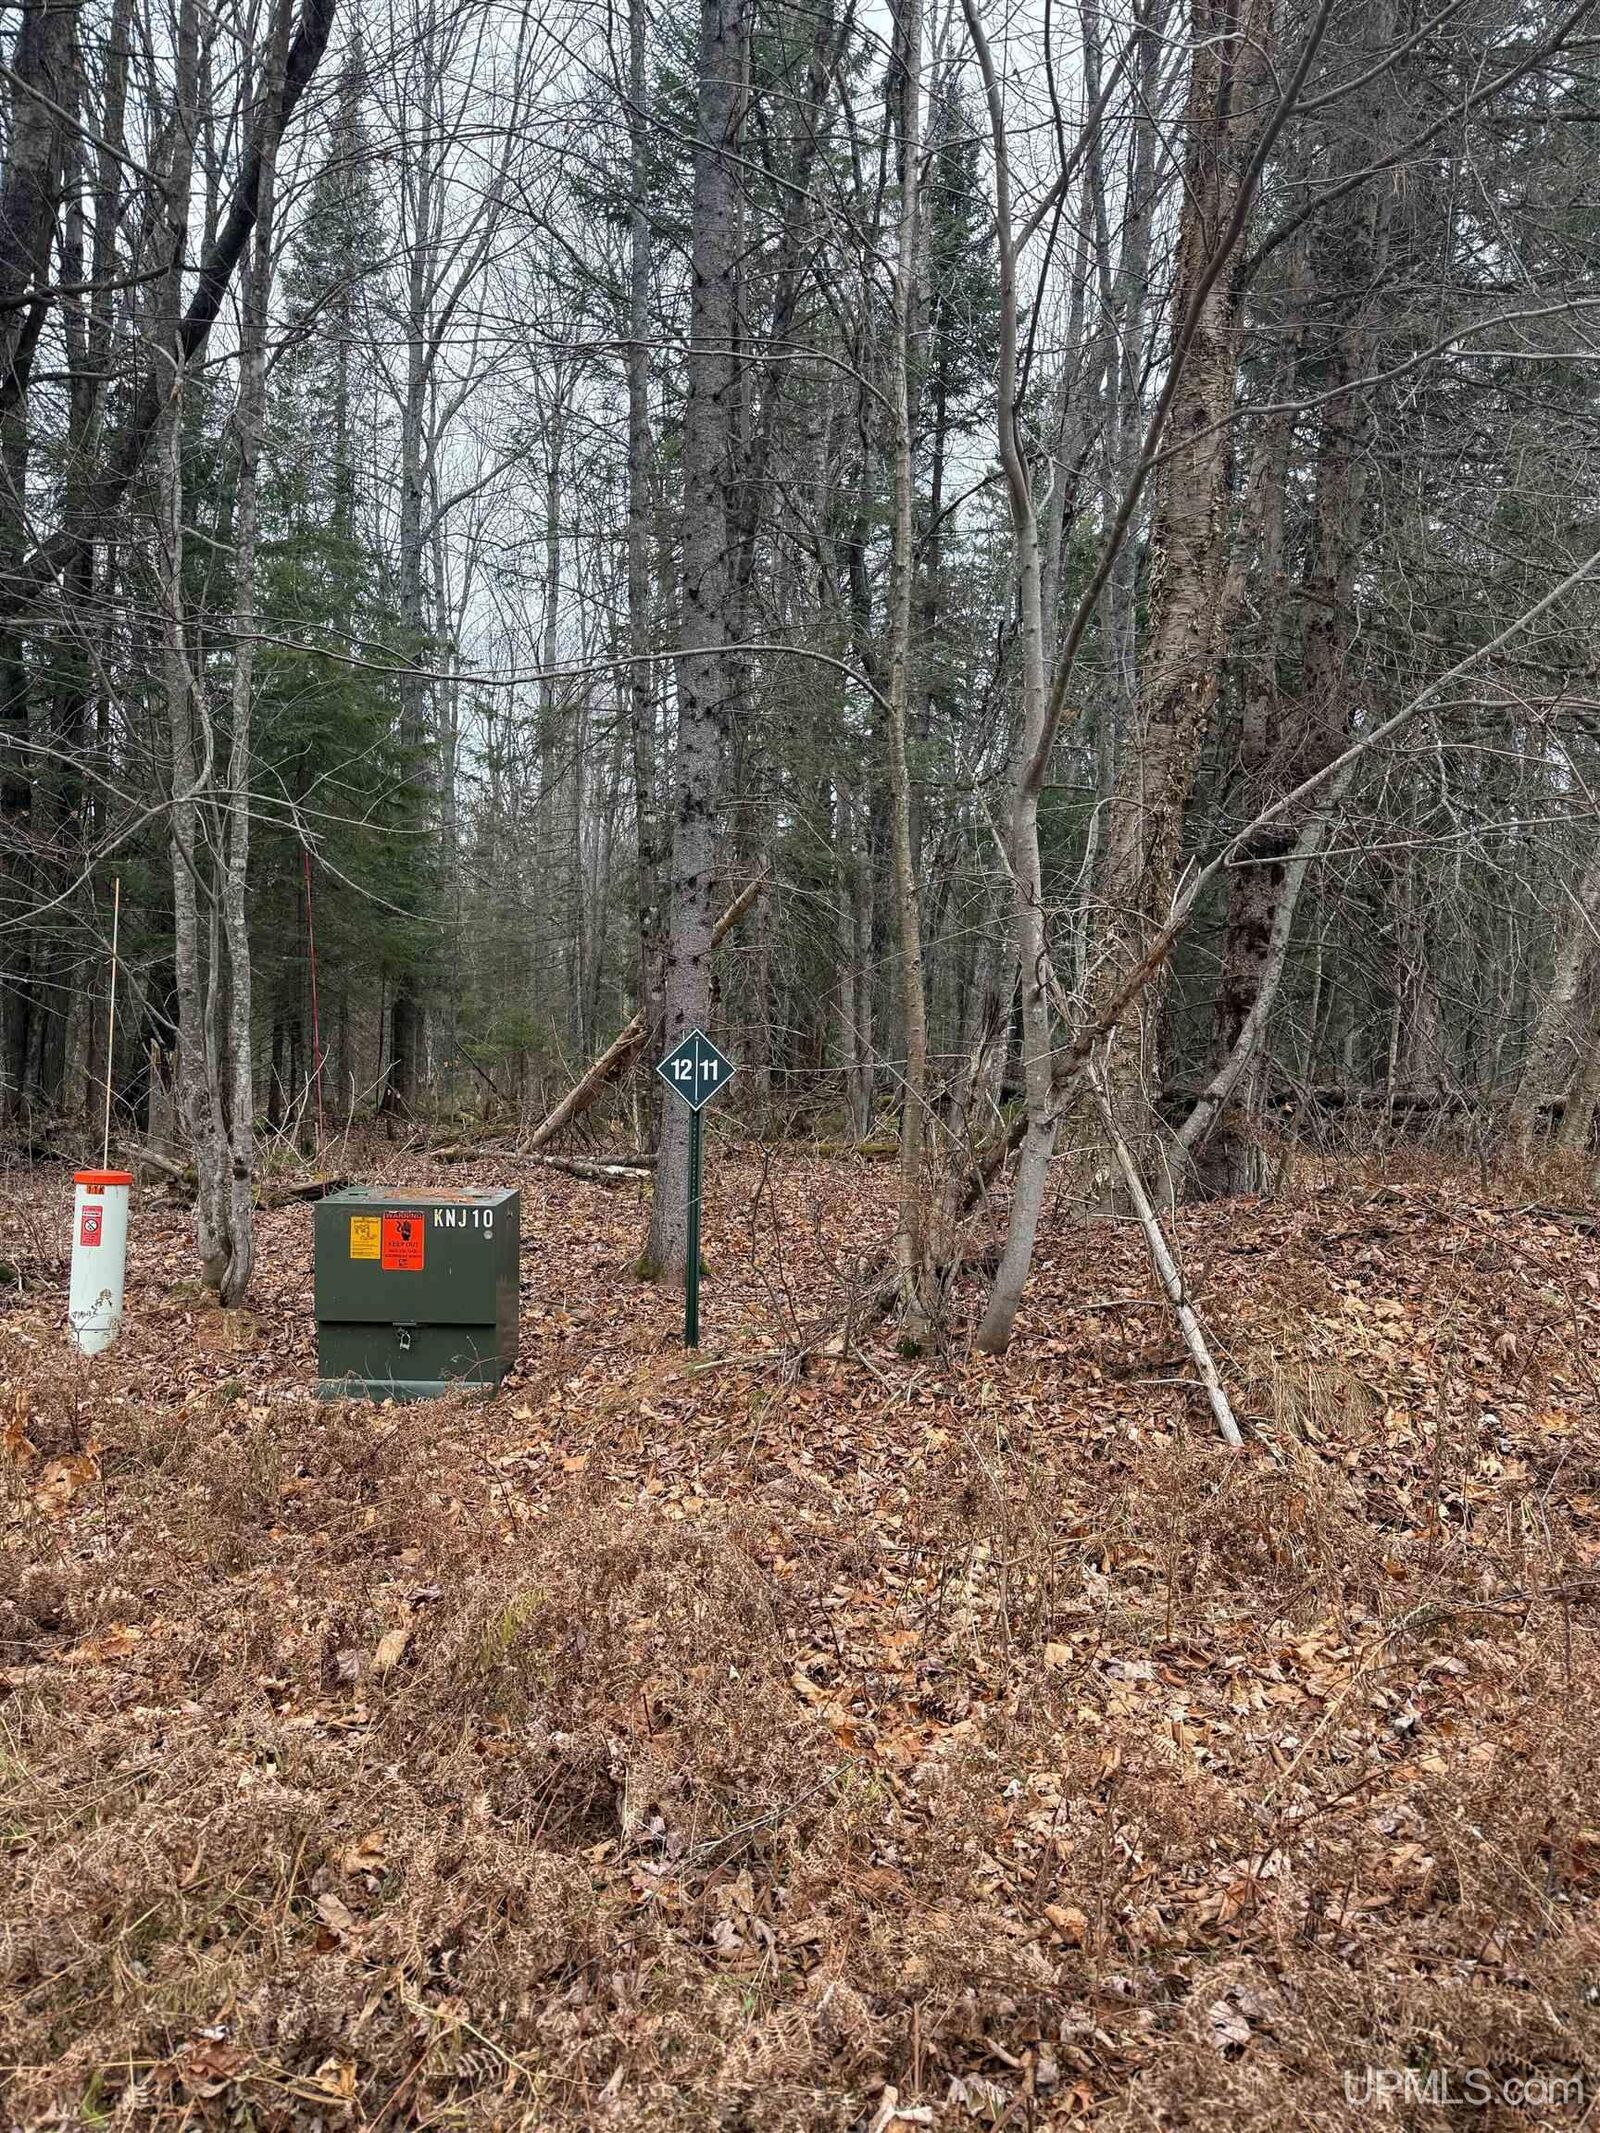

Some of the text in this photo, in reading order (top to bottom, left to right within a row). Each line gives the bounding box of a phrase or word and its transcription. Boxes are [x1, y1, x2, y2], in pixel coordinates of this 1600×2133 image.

[670, 1058, 718, 1081] 12 11
[433, 1208, 494, 1228] KNJ 10
